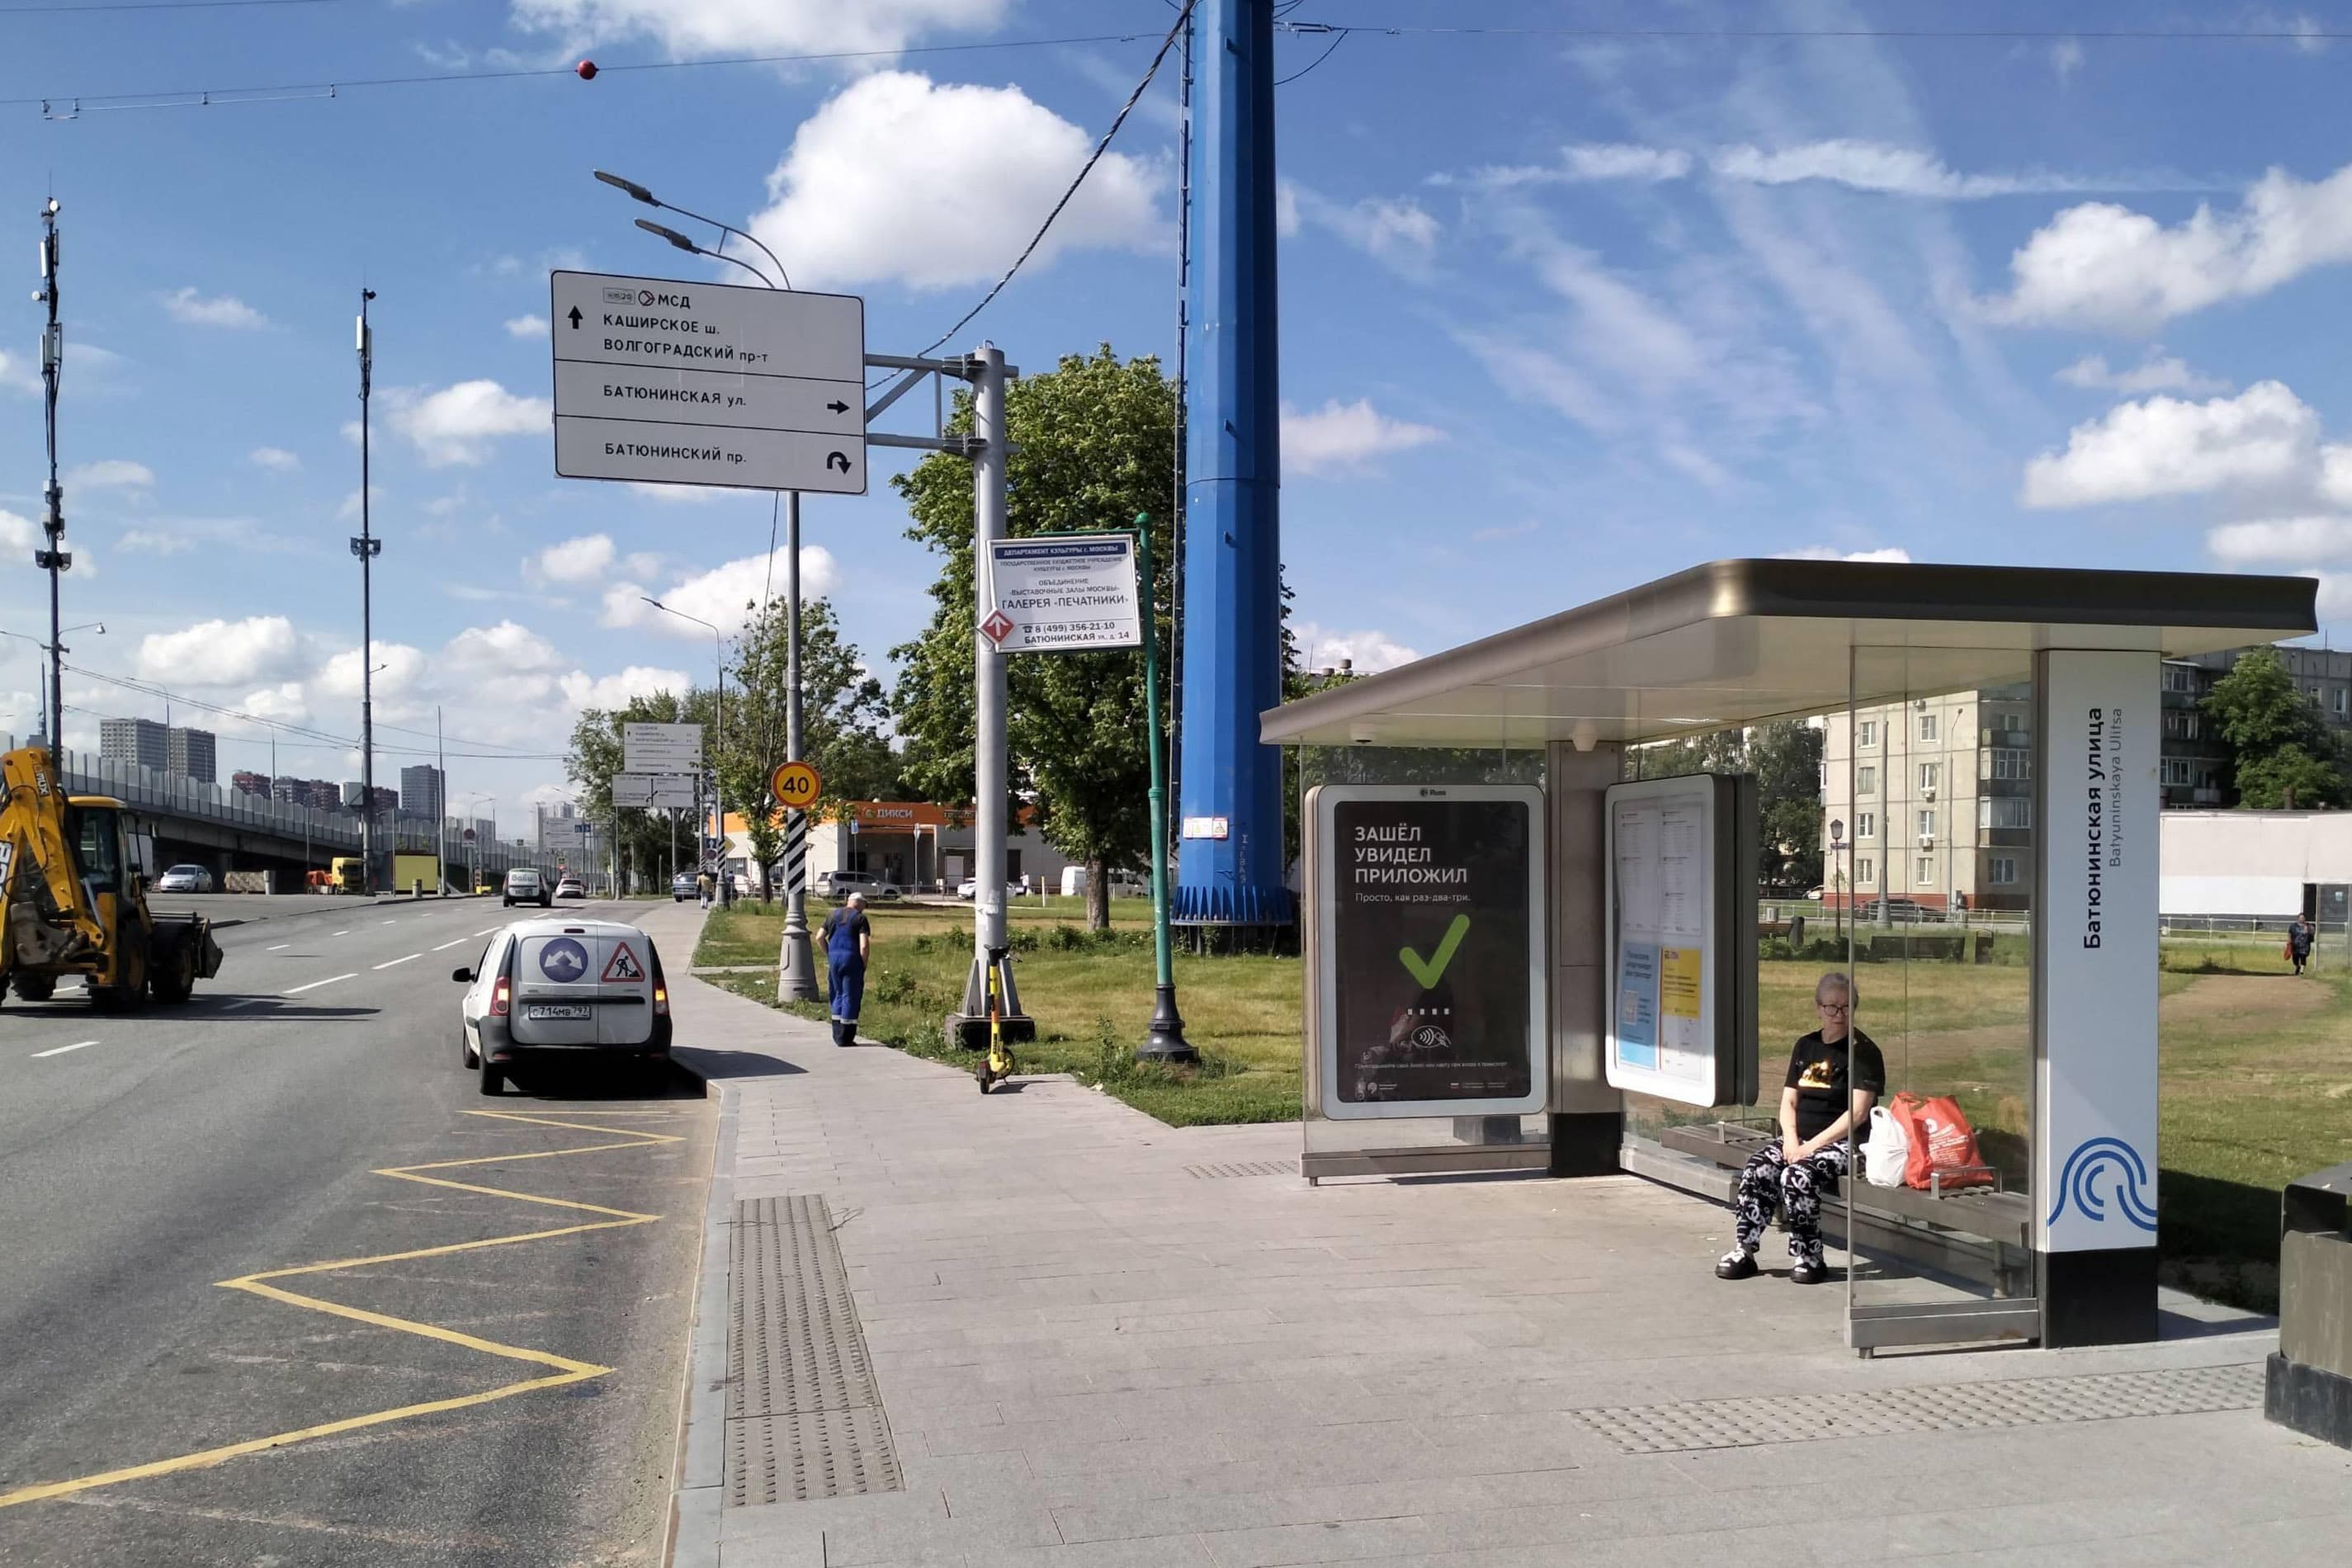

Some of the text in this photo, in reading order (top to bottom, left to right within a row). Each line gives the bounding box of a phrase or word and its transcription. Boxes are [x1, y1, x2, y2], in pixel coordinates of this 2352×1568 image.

[658, 294, 691, 309] МСД
[603, 314, 720, 335] КАШИРСКОЕ ш.
[603, 338, 769, 363] ВОЛГОГРАДСКИЙ пр-т
[603, 385, 747, 407] БАТЮНИНСКАЯ ул.
[605, 442, 747, 465] БАТЮНИНСКИЙ пр.
[1038, 578, 1089, 586] ОБЪЕДИНЕНИЕ
[1002, 597, 1051, 610] ГАЛЕРЕЯ
[1043, 624, 1068, 634] (499)
[1070, 621, 1115, 631] 356-21-10
[1024, 633, 1096, 645] БАТЮНИНСКАЯ
[1118, 631, 1130, 640] 14
[782, 776, 809, 794] 40
[2109, 708, 2124, 867] Batyuninskaya Ulitsa
[877, 809, 914, 819] ДИКСИ
[1354, 823, 1421, 842] ЗАШЁЛ
[2084, 708, 2105, 949] Батюнинская улица
[1354, 848, 1431, 865] УВИДЕЛ
[1355, 868, 1468, 883] ПРИЛОЖИЛ
[1355, 892, 1393, 903] Просто,
[1413, 893, 1471, 903] раз-два-три.
